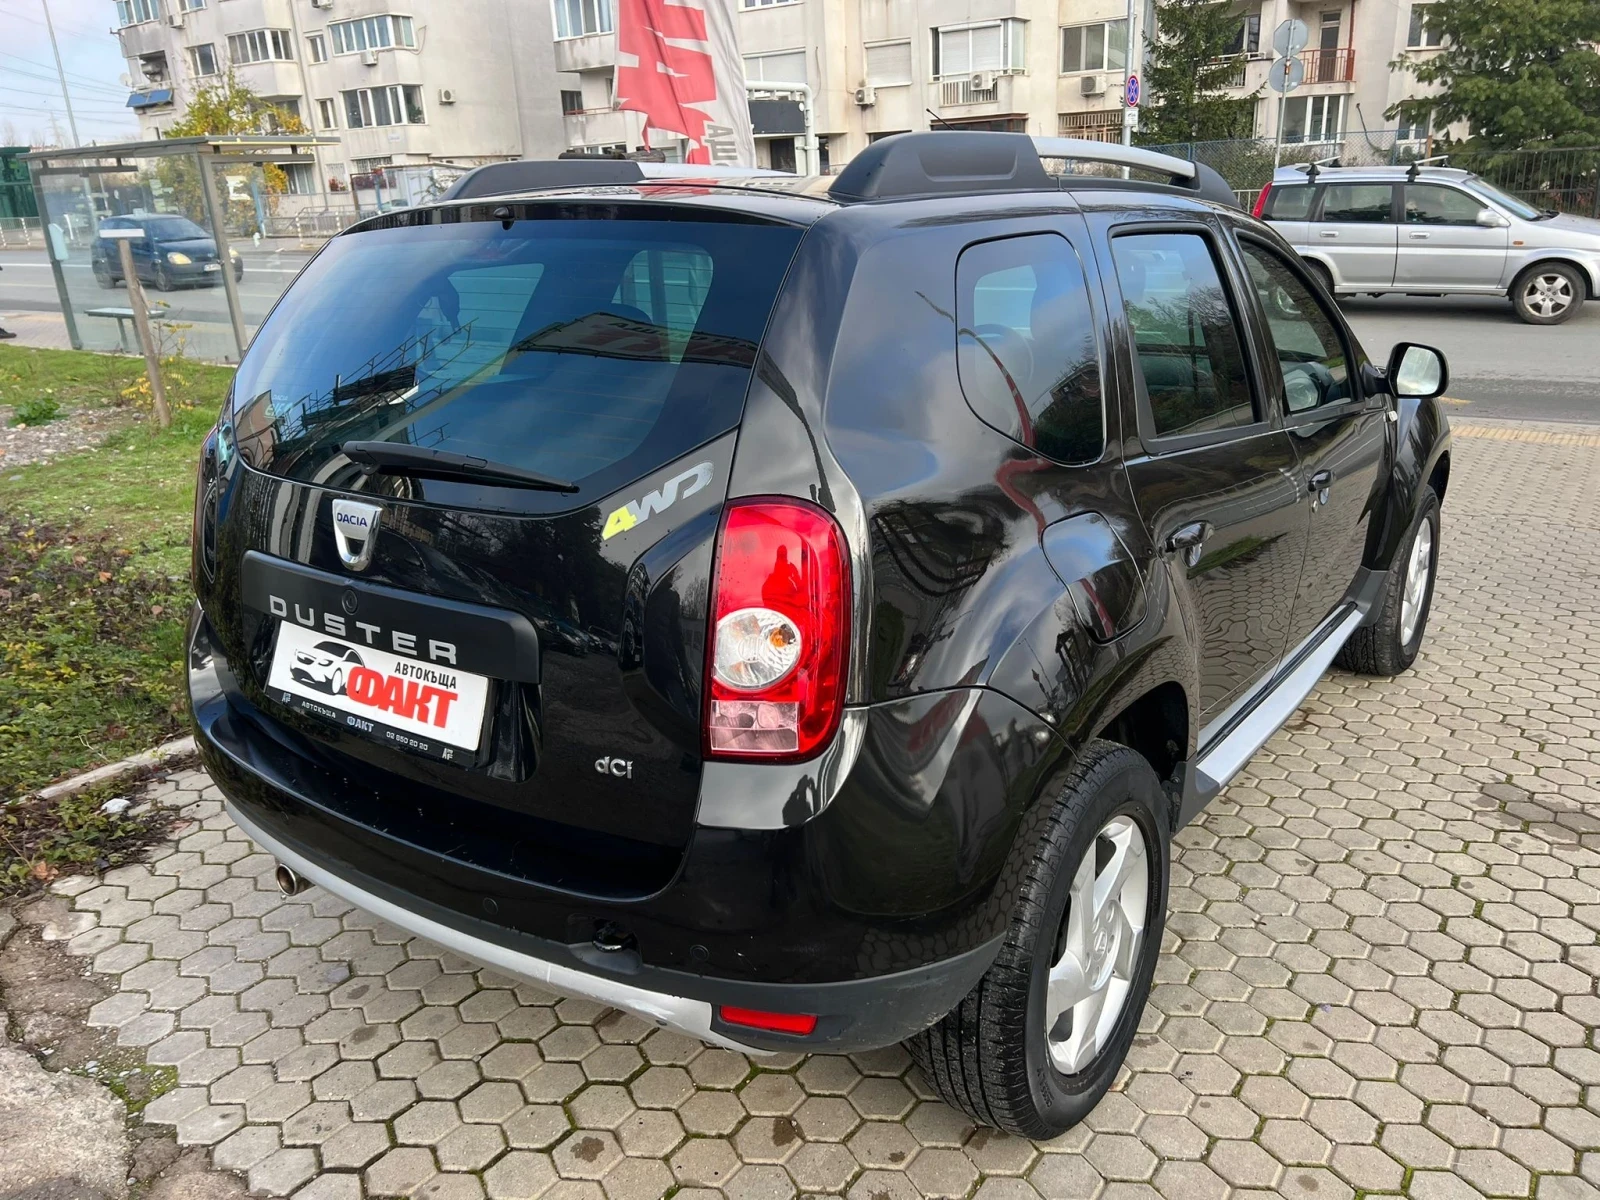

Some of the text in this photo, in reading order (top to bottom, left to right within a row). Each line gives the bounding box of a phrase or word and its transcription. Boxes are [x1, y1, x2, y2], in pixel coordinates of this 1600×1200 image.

[336, 512, 368, 528] DACIA
[602, 462, 714, 541] 4WD
[269, 594, 458, 665] DUSTER
[346, 666, 459, 729] ФАКТ
[394, 661, 458, 690] АВТОКЪЩА
[346, 716, 375, 733] ФАКТ
[386, 731, 395, 740] 02
[409, 739, 418, 747] 20
[418, 742, 429, 751] 20
